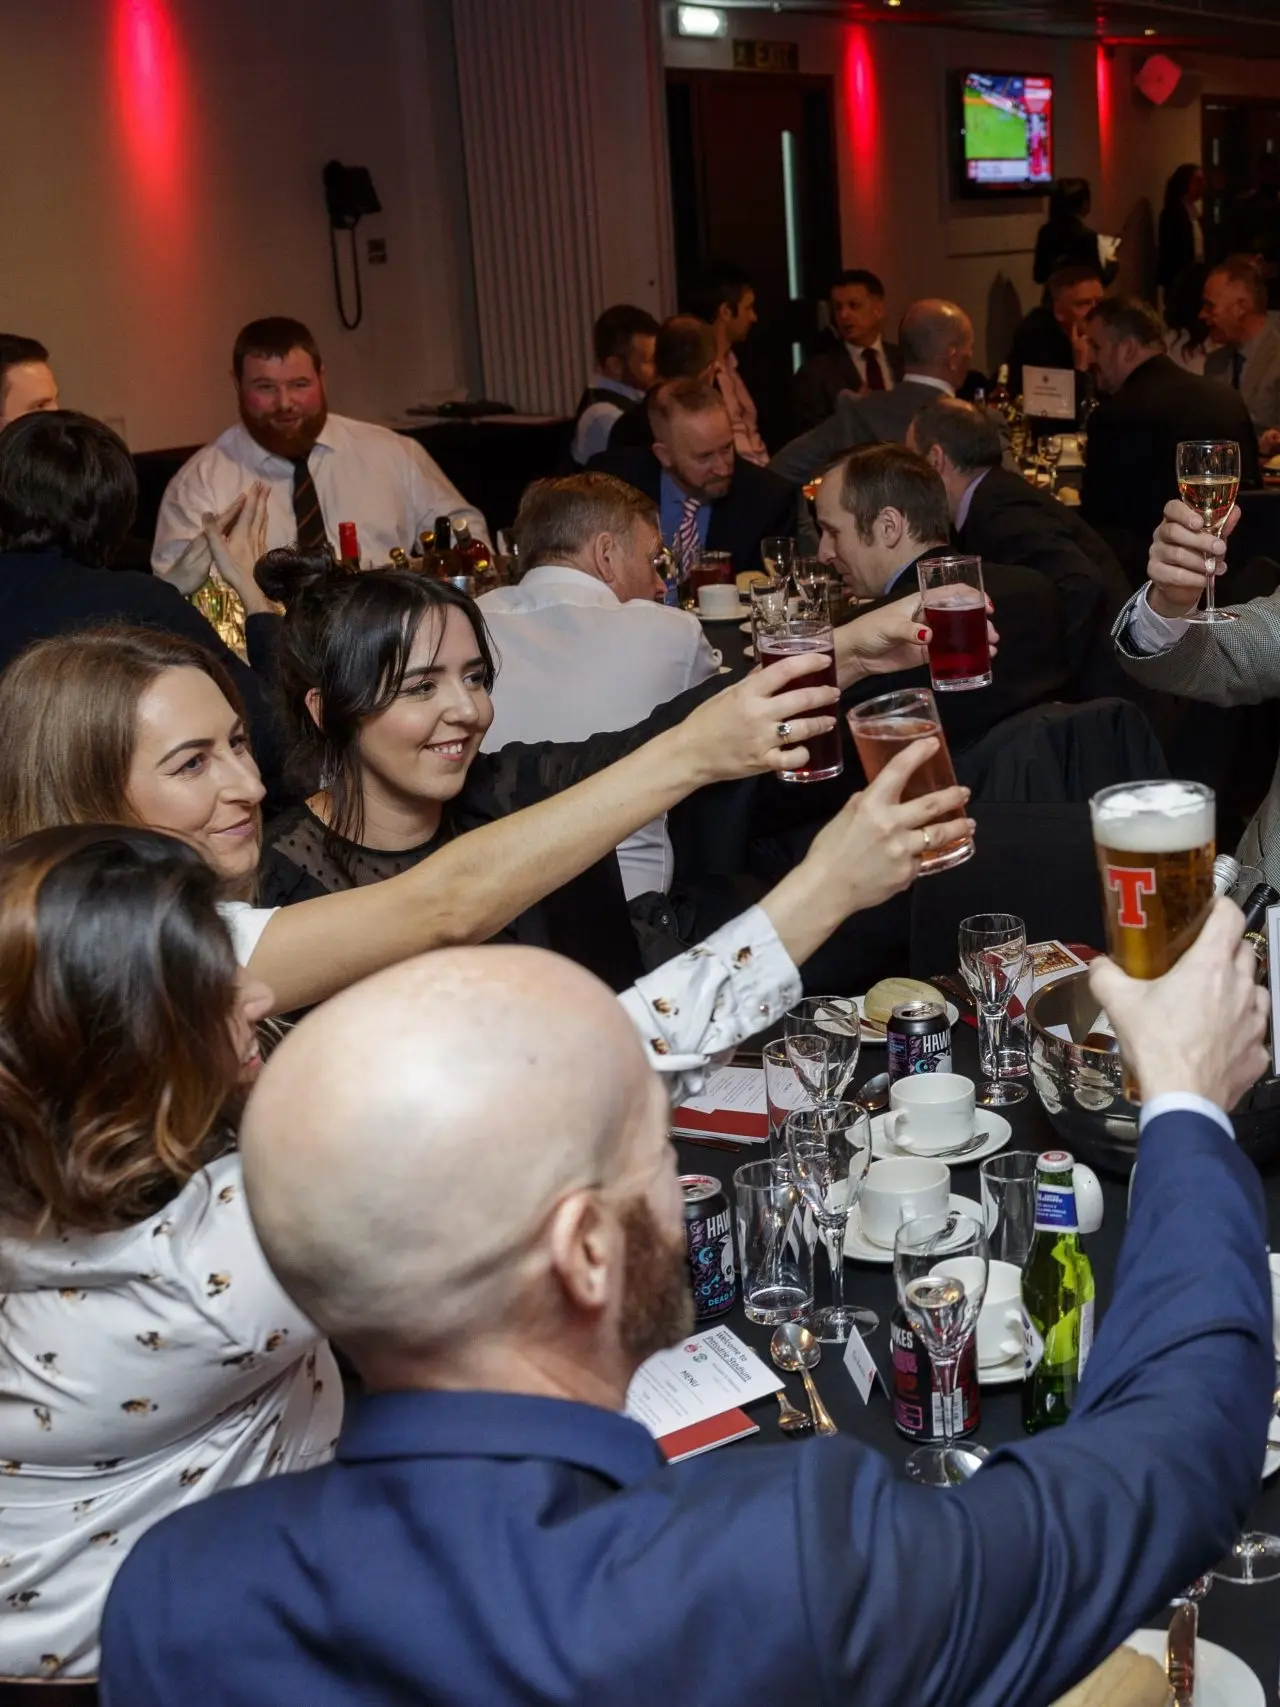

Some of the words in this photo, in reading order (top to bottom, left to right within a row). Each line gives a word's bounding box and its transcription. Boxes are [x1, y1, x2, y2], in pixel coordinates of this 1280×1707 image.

[1105, 865, 1156, 928] T
[708, 1293, 729, 1306] DEAD
[680, 1369, 700, 1387] MENU
